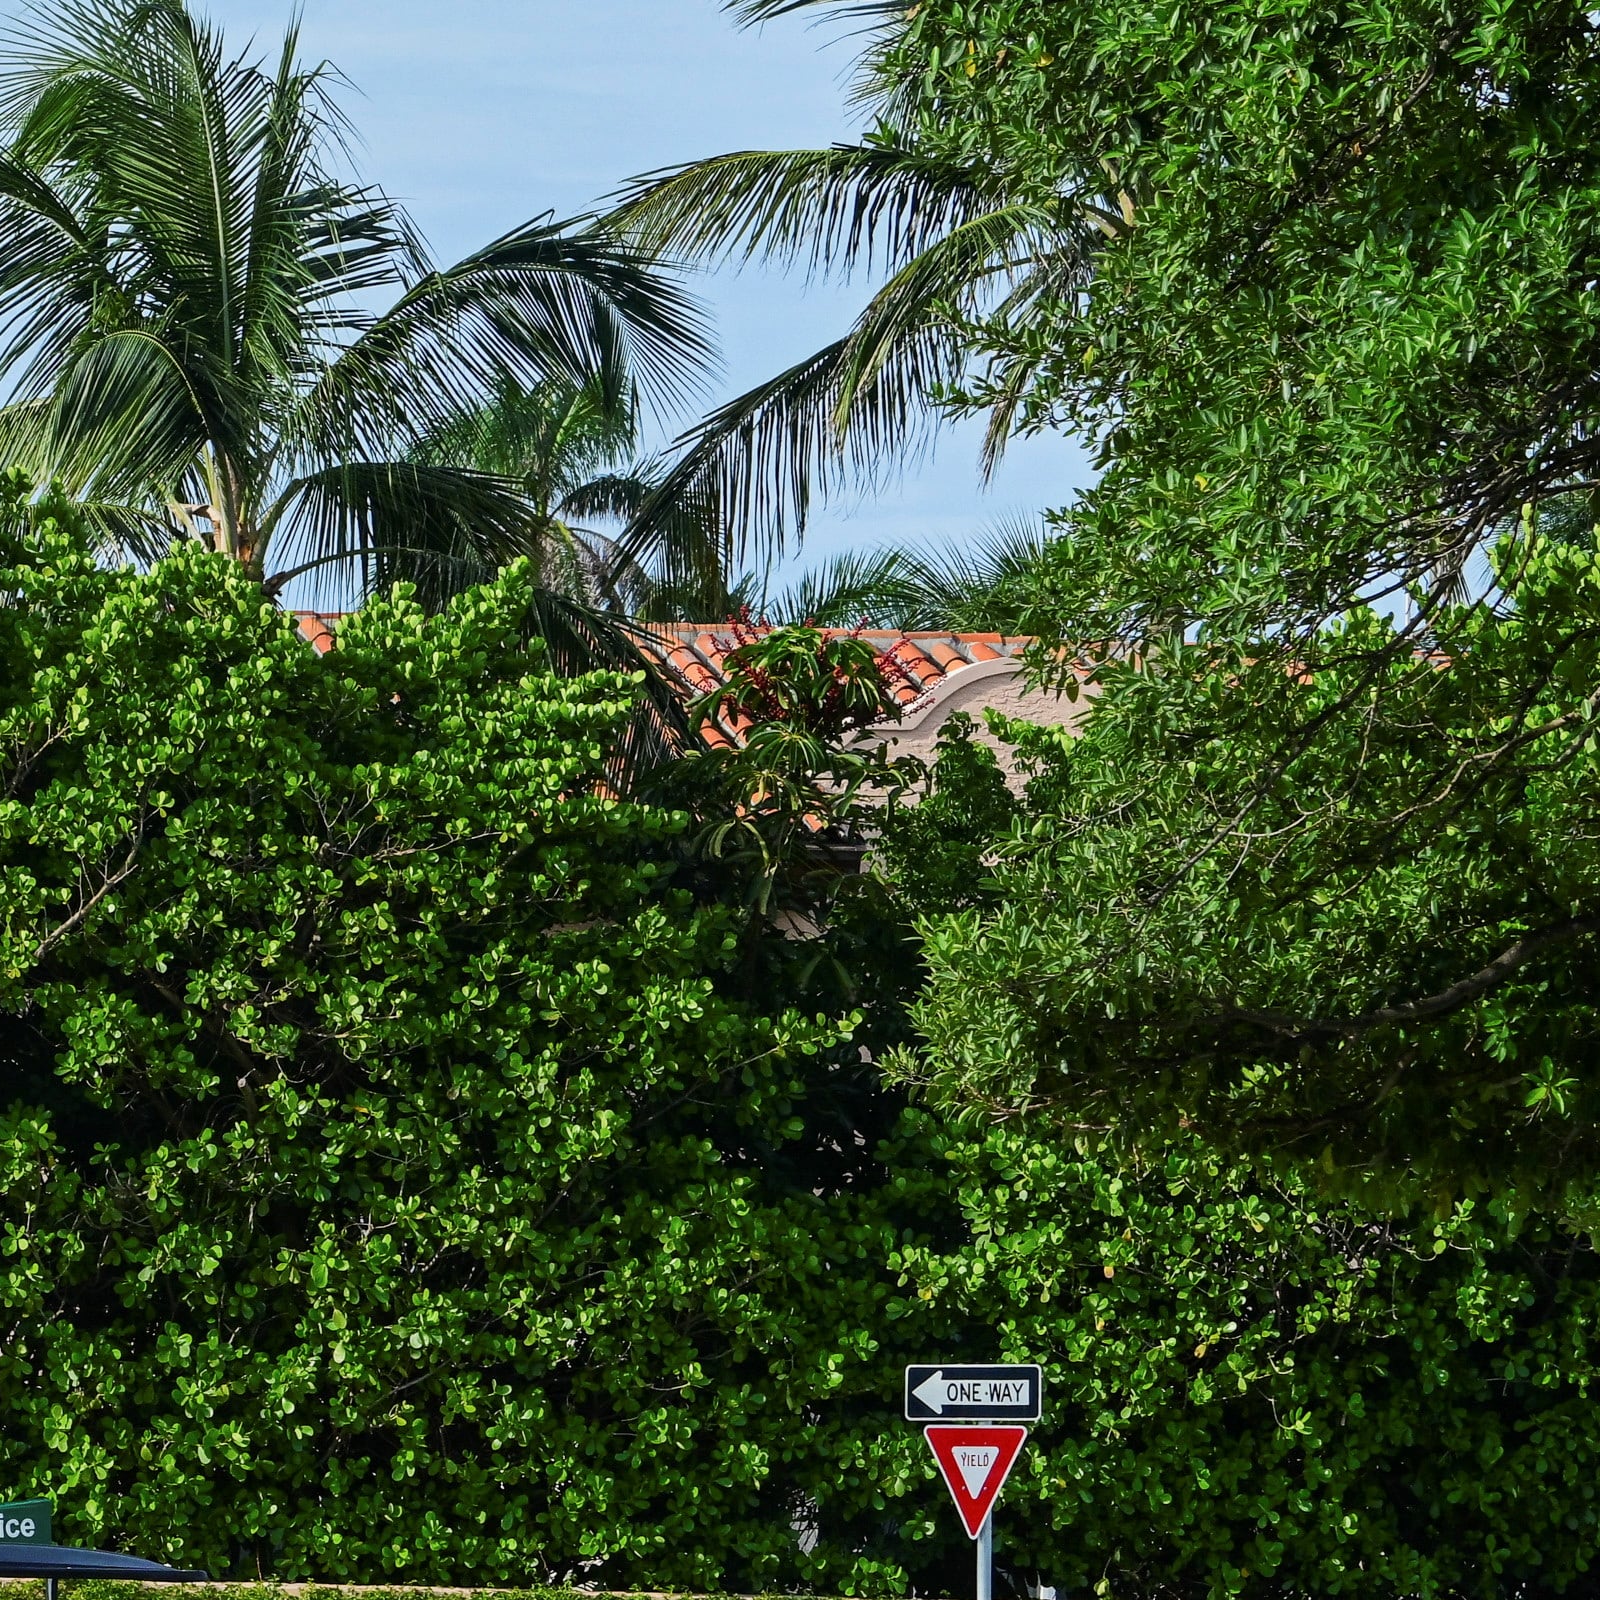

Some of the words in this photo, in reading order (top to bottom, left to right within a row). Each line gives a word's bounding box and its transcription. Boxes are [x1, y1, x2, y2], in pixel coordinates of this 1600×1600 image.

[946, 1382, 982, 1403] ONE
[988, 1382, 1024, 1403] WAY
[961, 1454, 989, 1466] YIELD
